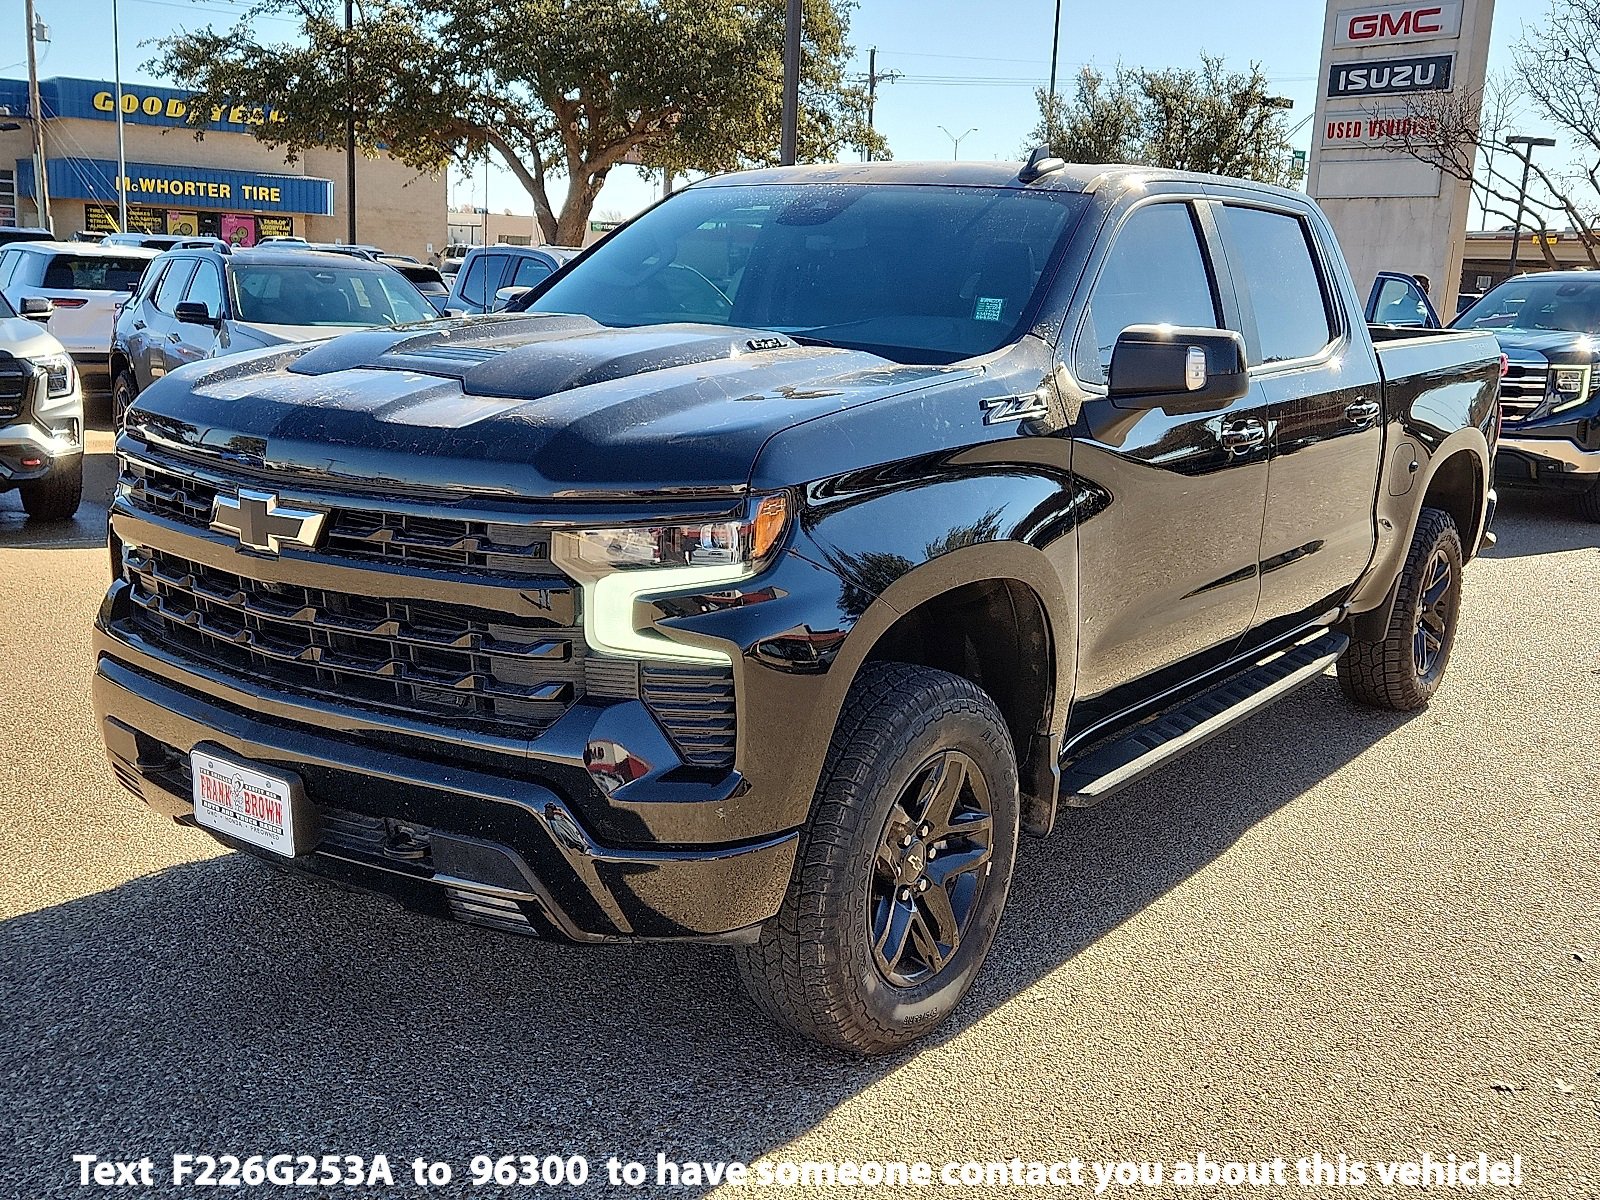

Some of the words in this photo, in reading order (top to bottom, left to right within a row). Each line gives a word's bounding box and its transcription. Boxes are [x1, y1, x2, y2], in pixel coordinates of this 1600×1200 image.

[1348, 8, 1443, 40] GMC
[1338, 63, 1436, 91] ISUZU
[1327, 120, 1362, 139] USED
[115, 176, 231, 199] McWHORTER
[242, 185, 281, 202] TIRE
[200, 774, 233, 809] FRANK
[243, 790, 283, 827] BROWN
